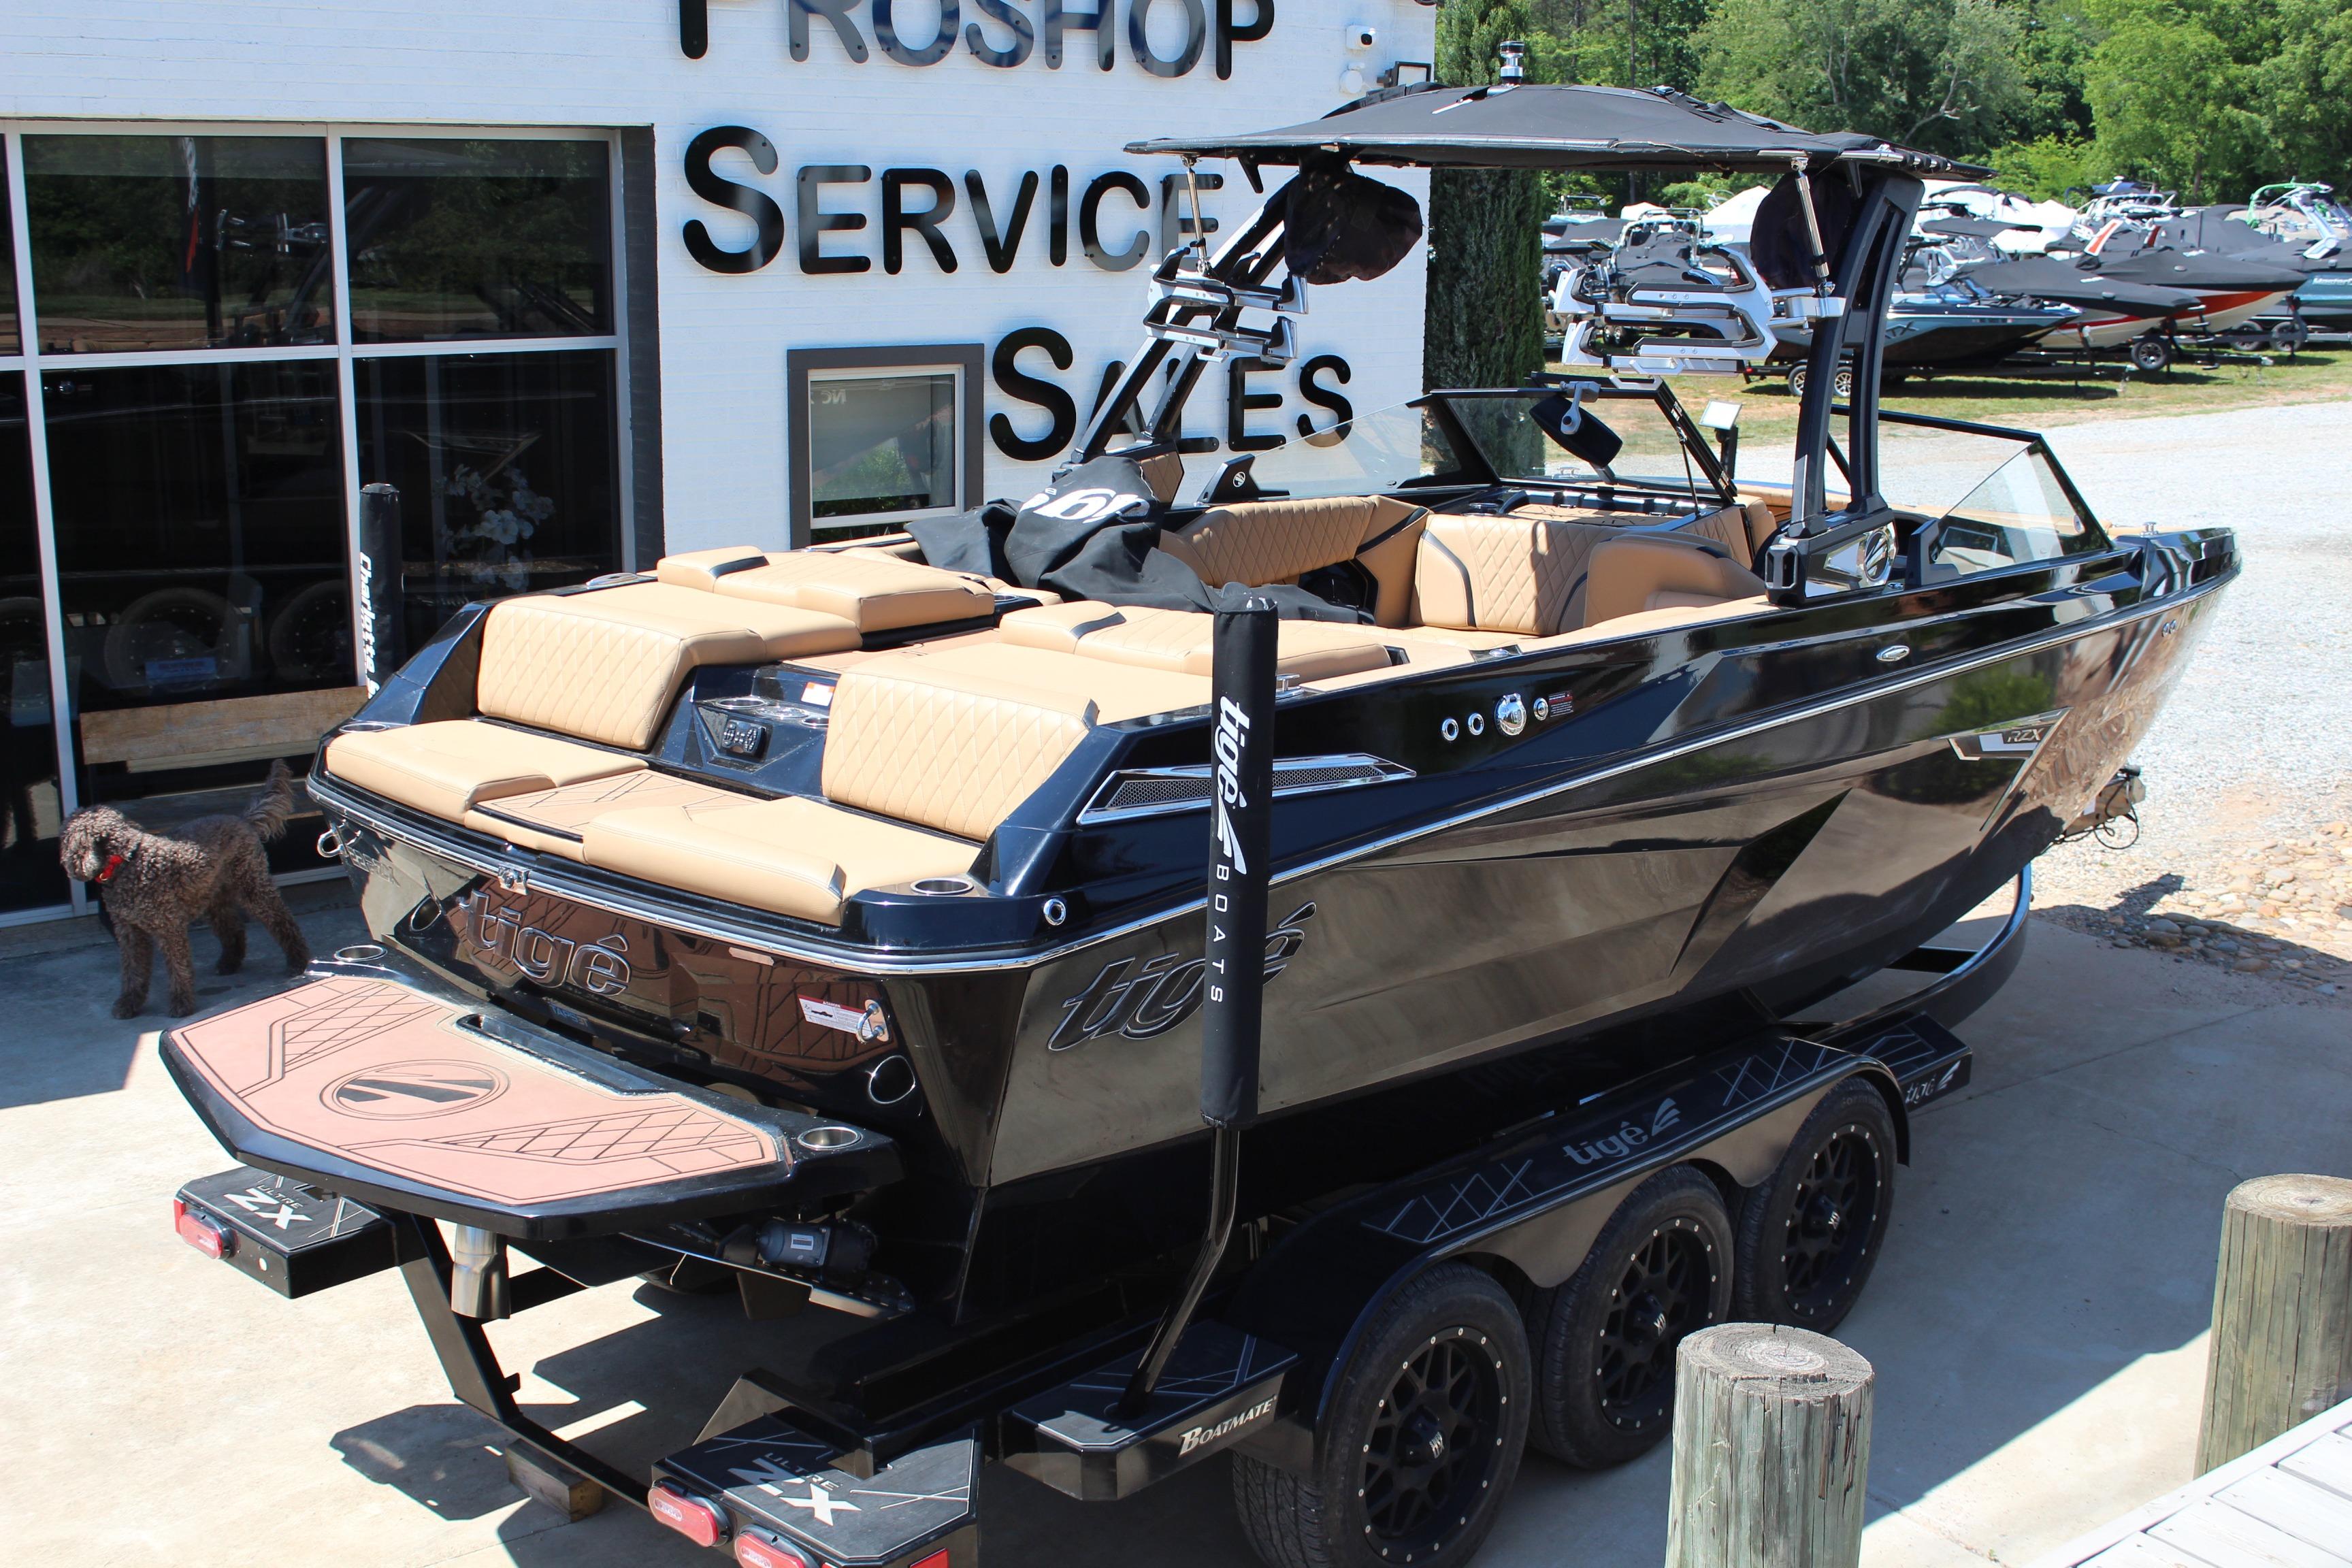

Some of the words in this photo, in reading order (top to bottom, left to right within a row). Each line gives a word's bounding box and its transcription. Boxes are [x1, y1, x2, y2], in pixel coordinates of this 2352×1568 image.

[359, 551, 376, 674] Charlotte
[2007, 728, 2044, 742] RZX
[1210, 865, 1229, 1003] BOATS
[257, 1186, 304, 1209] ULTRE
[1178, 1399, 1275, 1459] BOATMATE
